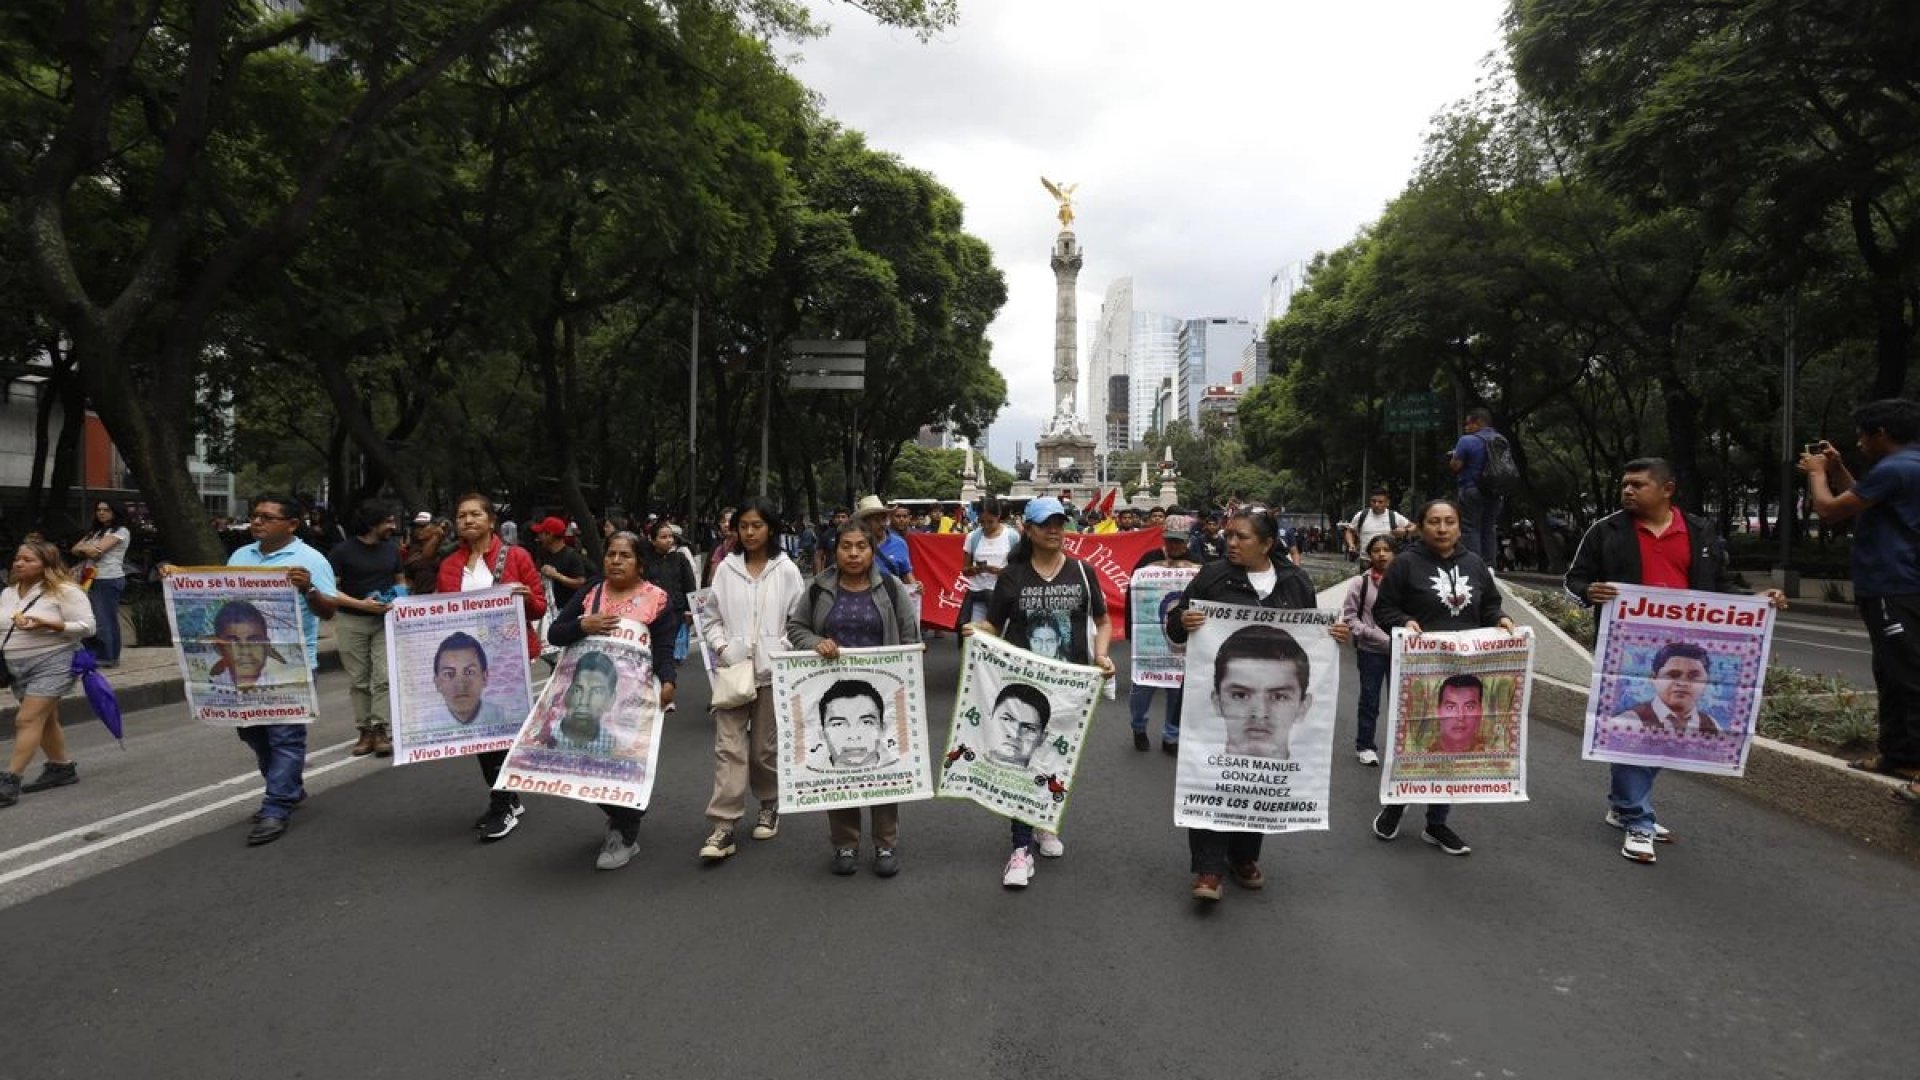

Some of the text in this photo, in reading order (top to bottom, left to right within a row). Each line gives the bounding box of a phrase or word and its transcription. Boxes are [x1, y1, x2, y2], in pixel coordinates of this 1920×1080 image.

[173, 576, 292, 591] ¡Vivo se lo llevaron!
[1045, 584, 1081, 596] ANTONIO
[396, 606, 426, 622] ¡Vivo
[429, 605, 444, 615] se
[447, 601, 459, 612] lo
[462, 596, 513, 611] llevaron!
[1235, 609, 1251, 620] SE
[1254, 611, 1276, 622] LOS
[1617, 597, 1767, 628] ¡Justicia!
[1404, 637, 1527, 653] ¡Vivo se lo llevaron!
[786, 653, 903, 671] ¡Vivo se lo llevaron!
[977, 651, 1007, 668] ¡Vivo
[1008, 665, 1022, 675] se
[1023, 667, 1034, 679] lo
[1037, 671, 1089, 689] llevaron!
[1141, 671, 1162, 681] ¡Vivo
[1165, 672, 1173, 681] lo
[201, 706, 307, 720] ¡Vivo lo queremos!
[965, 706, 981, 726] 43
[409, 748, 441, 763] ¡Vivo
[444, 745, 457, 756] lo
[1052, 735, 1069, 756] 43
[1207, 755, 1301, 772] CÉSAR MANUEL
[877, 770, 914, 781] BAUTISTA
[1221, 771, 1289, 785] GONZÁLEZ
[506, 773, 636, 803] Dónde están
[949, 772, 1049, 811] ¡Con VIDA lo queremos!
[1215, 783, 1291, 798] HERNÁNDEZ
[1396, 782, 1512, 797] ¡Vivo lo queremos!
[797, 785, 914, 809] ¡Con VIDA lo queremos!
[1184, 794, 1318, 812] ¡VIVOS LOS QUEREMOS!
